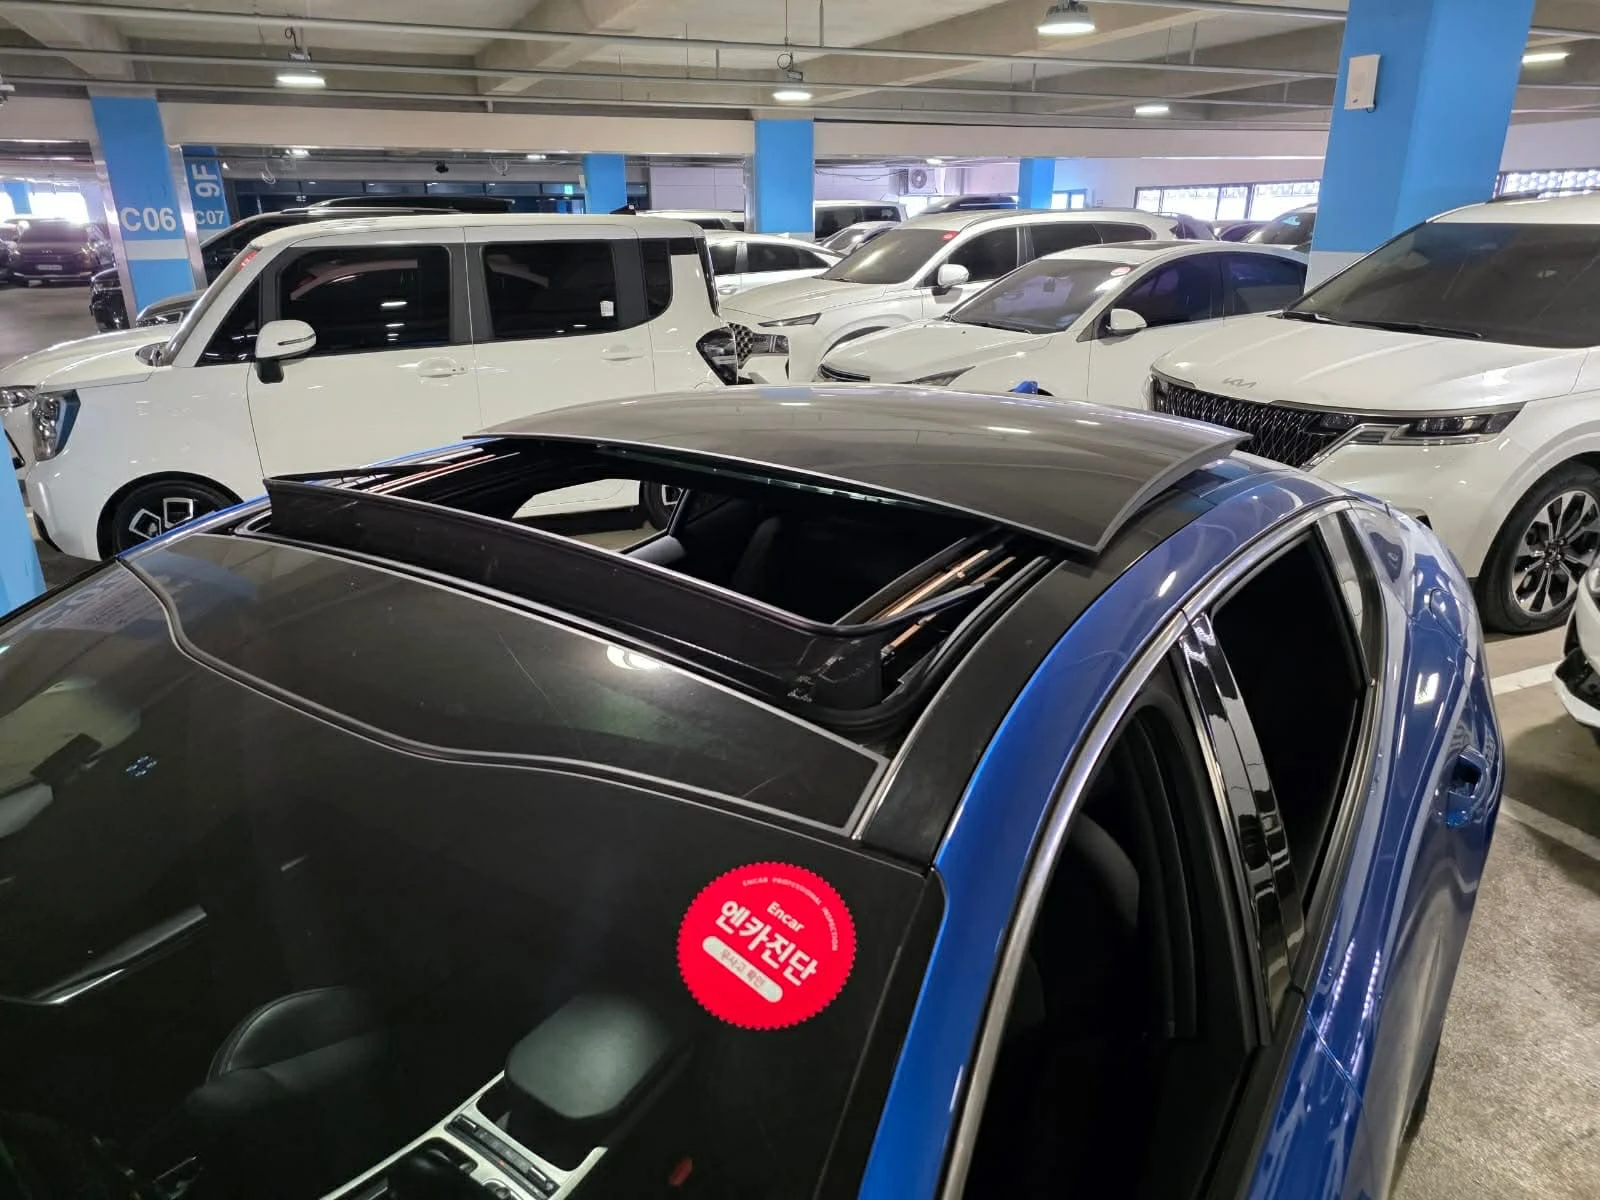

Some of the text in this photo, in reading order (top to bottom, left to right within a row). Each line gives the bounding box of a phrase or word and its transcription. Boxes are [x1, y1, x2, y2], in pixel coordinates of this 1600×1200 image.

[191, 163, 220, 198] 9F
[120, 207, 177, 232] C06
[194, 210, 225, 225] C07
[766, 900, 805, 933] Encar
[714, 899, 819, 987] 엔카진단
